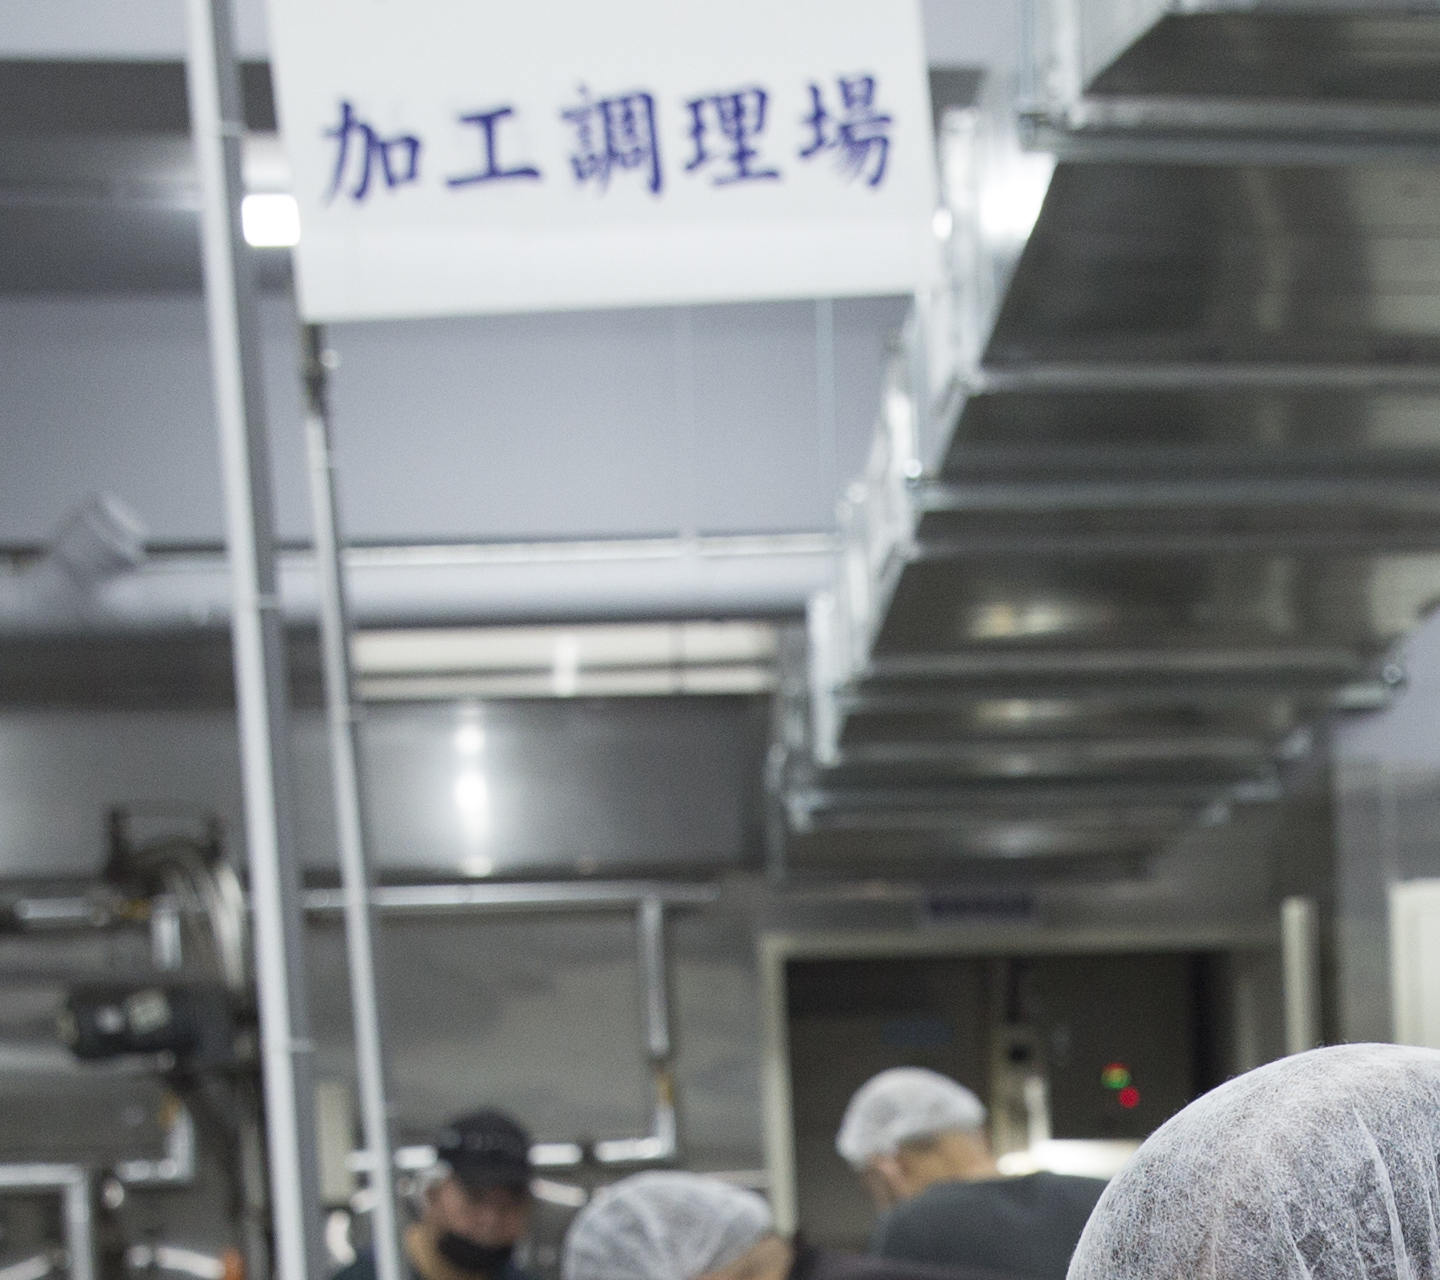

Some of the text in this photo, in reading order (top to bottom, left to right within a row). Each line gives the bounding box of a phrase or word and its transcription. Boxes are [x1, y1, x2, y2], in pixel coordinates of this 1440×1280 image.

[322, 72, 896, 206] 加工調理場
